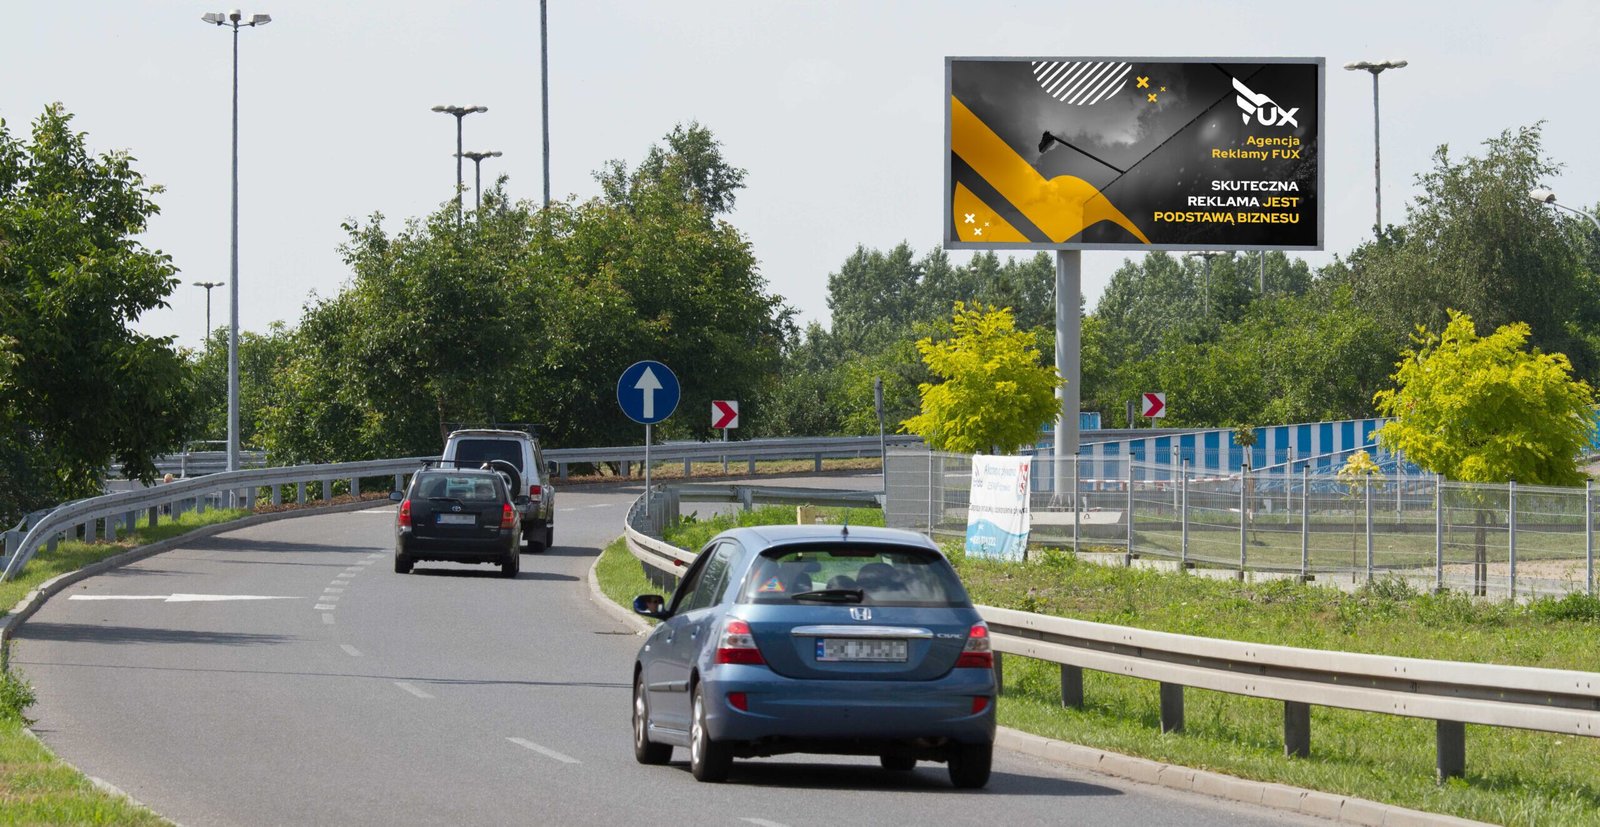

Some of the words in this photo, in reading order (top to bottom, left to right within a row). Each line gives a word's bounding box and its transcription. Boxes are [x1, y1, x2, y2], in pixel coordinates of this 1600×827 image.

[1232, 77, 1300, 128] FUX
[1246, 136, 1300, 147] Agencja
[1212, 148, 1268, 161] Reklamy
[1272, 149, 1300, 159] FUX
[1211, 180, 1299, 191] SKUTECZNA
[1187, 195, 1260, 207] REKLAMA
[1262, 196, 1300, 208] JEST
[1154, 211, 1235, 226] PODSTAWĄ
[1237, 212, 1300, 224] BIZNESU
